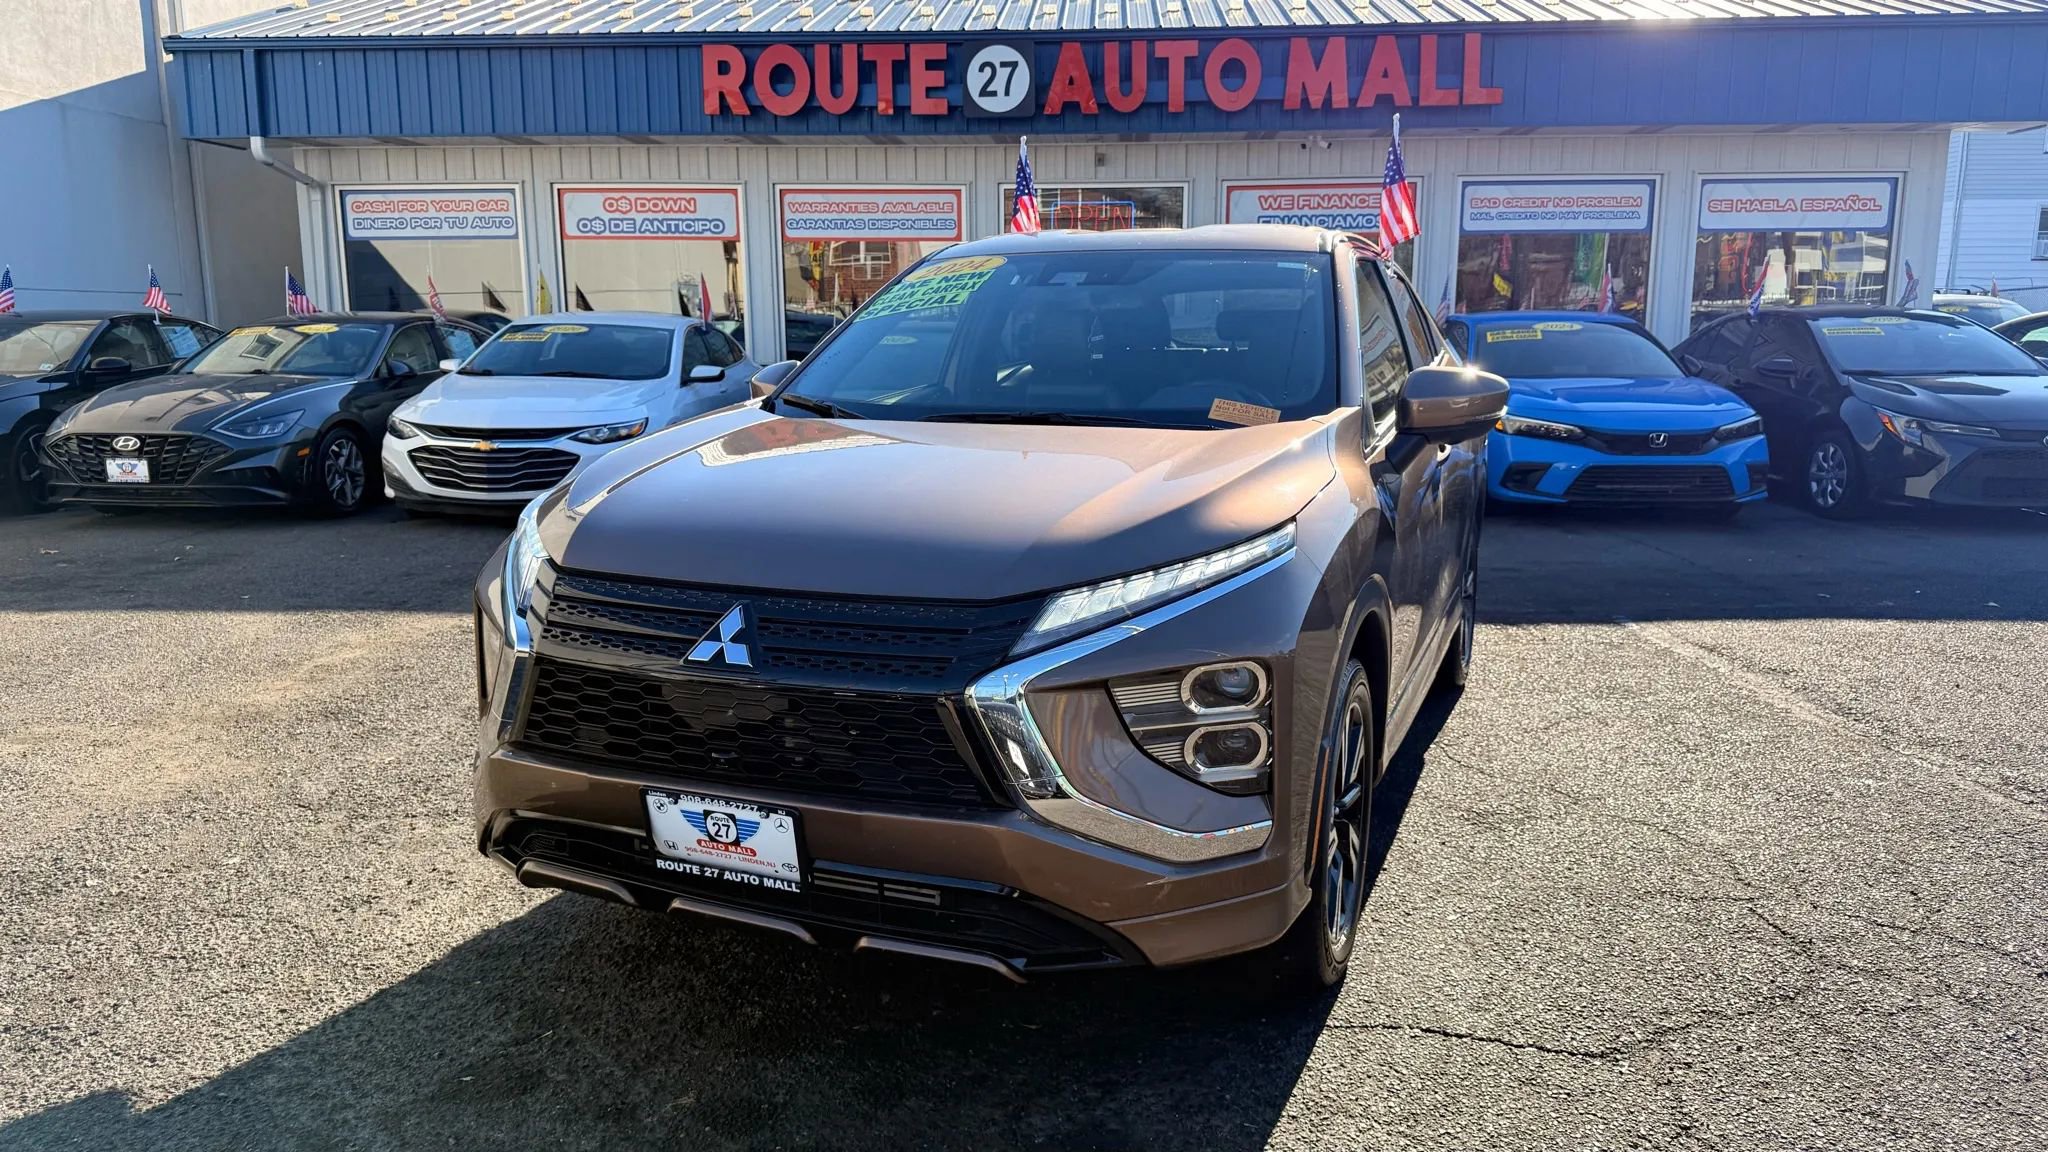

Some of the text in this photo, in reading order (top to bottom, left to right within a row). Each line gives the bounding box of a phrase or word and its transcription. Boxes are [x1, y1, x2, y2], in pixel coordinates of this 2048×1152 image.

[702, 32, 1503, 117] ROUTE 27 AUTO MALL
[351, 200, 509, 213] CASH FOR YOUR CAR
[634, 197, 697, 213] DOWN
[788, 202, 953, 214] WARRANTIES AVAILABLE
[1258, 193, 1381, 210] WE FINANCE
[1470, 196, 1642, 208] BAD CREDIT NO PROBLEM
[1708, 194, 1881, 212] SE HABLA ESPAÑOL
[353, 216, 514, 230] DINERO POR TU AUTO
[1055, 205, 1131, 231] OPEN
[1258, 213, 1380, 231] FINANCIAMO
[1470, 210, 1641, 221] MAL CREDITO NO HAY PROBLEMA
[608, 218, 636, 234] DE
[638, 218, 725, 234] ANTICIPO
[786, 218, 957, 231] GARANTIAS DISPONIBLES
[916, 257, 993, 280] 2024
[884, 269, 993, 296] LIKE NEW
[872, 280, 981, 307] CLEAN CARFAX
[858, 293, 962, 319] SPECIAL
[1232, 406, 1251, 415] FOR
[709, 815, 731, 824] ROUTE
[712, 822, 732, 839] 27
[700, 840, 755, 857] AUTO MALL
[655, 859, 801, 893] ROUTE 27 AUTO MALL
